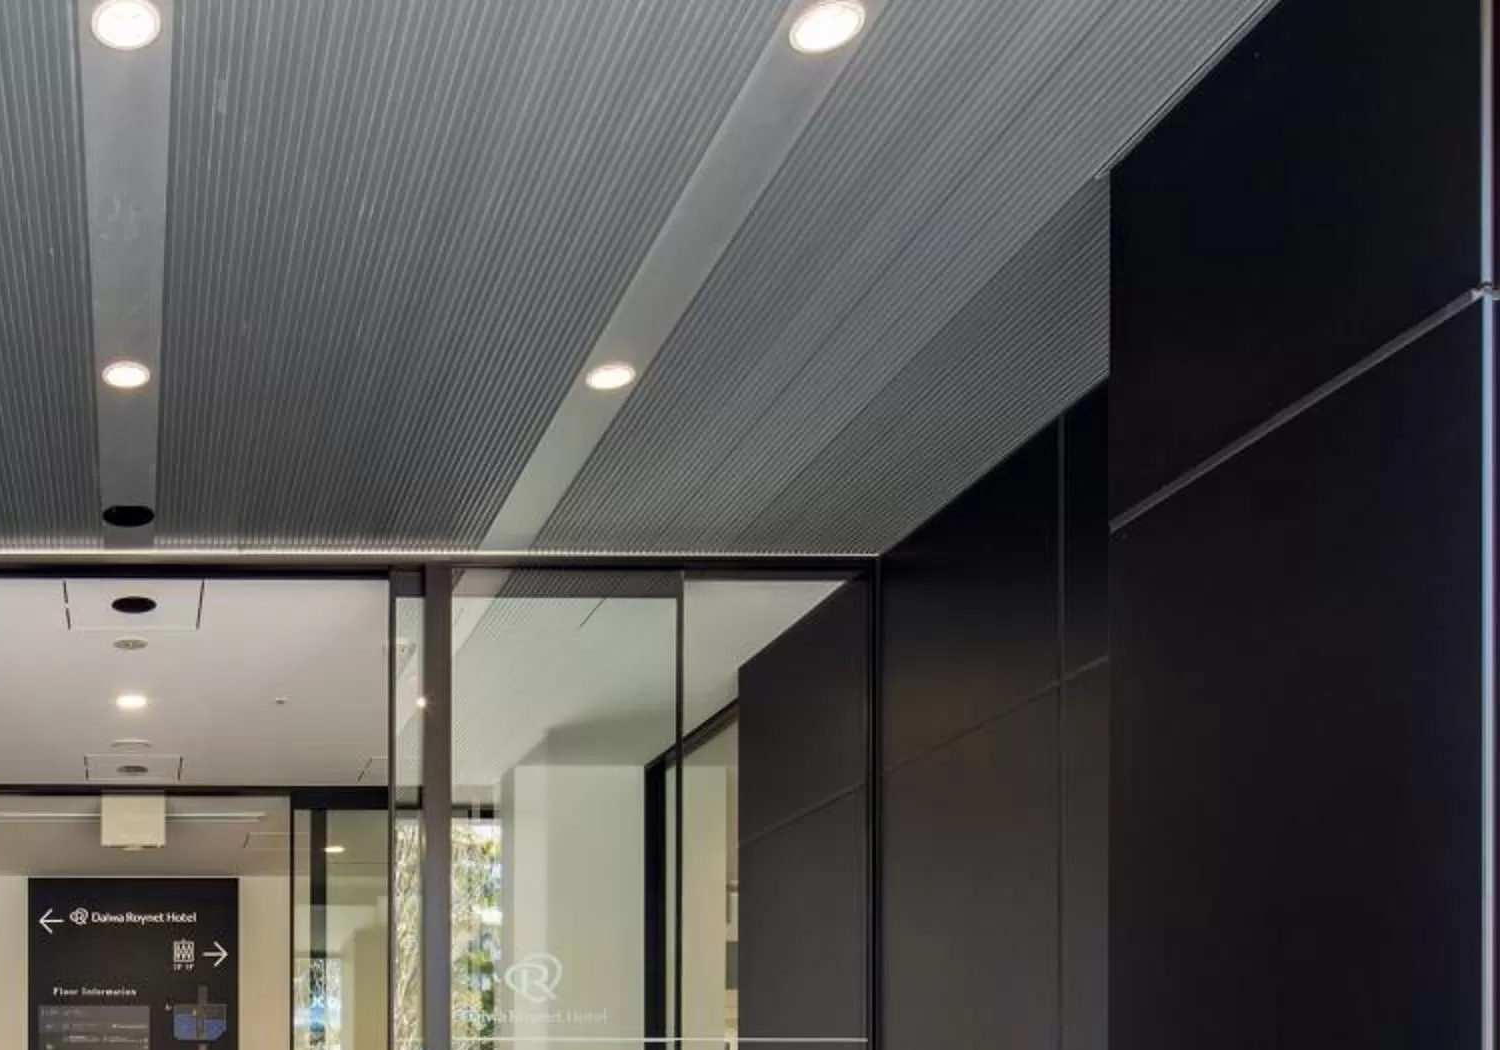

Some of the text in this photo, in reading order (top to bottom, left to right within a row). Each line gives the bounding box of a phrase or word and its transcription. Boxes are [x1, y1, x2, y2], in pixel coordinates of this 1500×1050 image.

[91, 912, 197, 925] Daiwa Roynet Hotel
